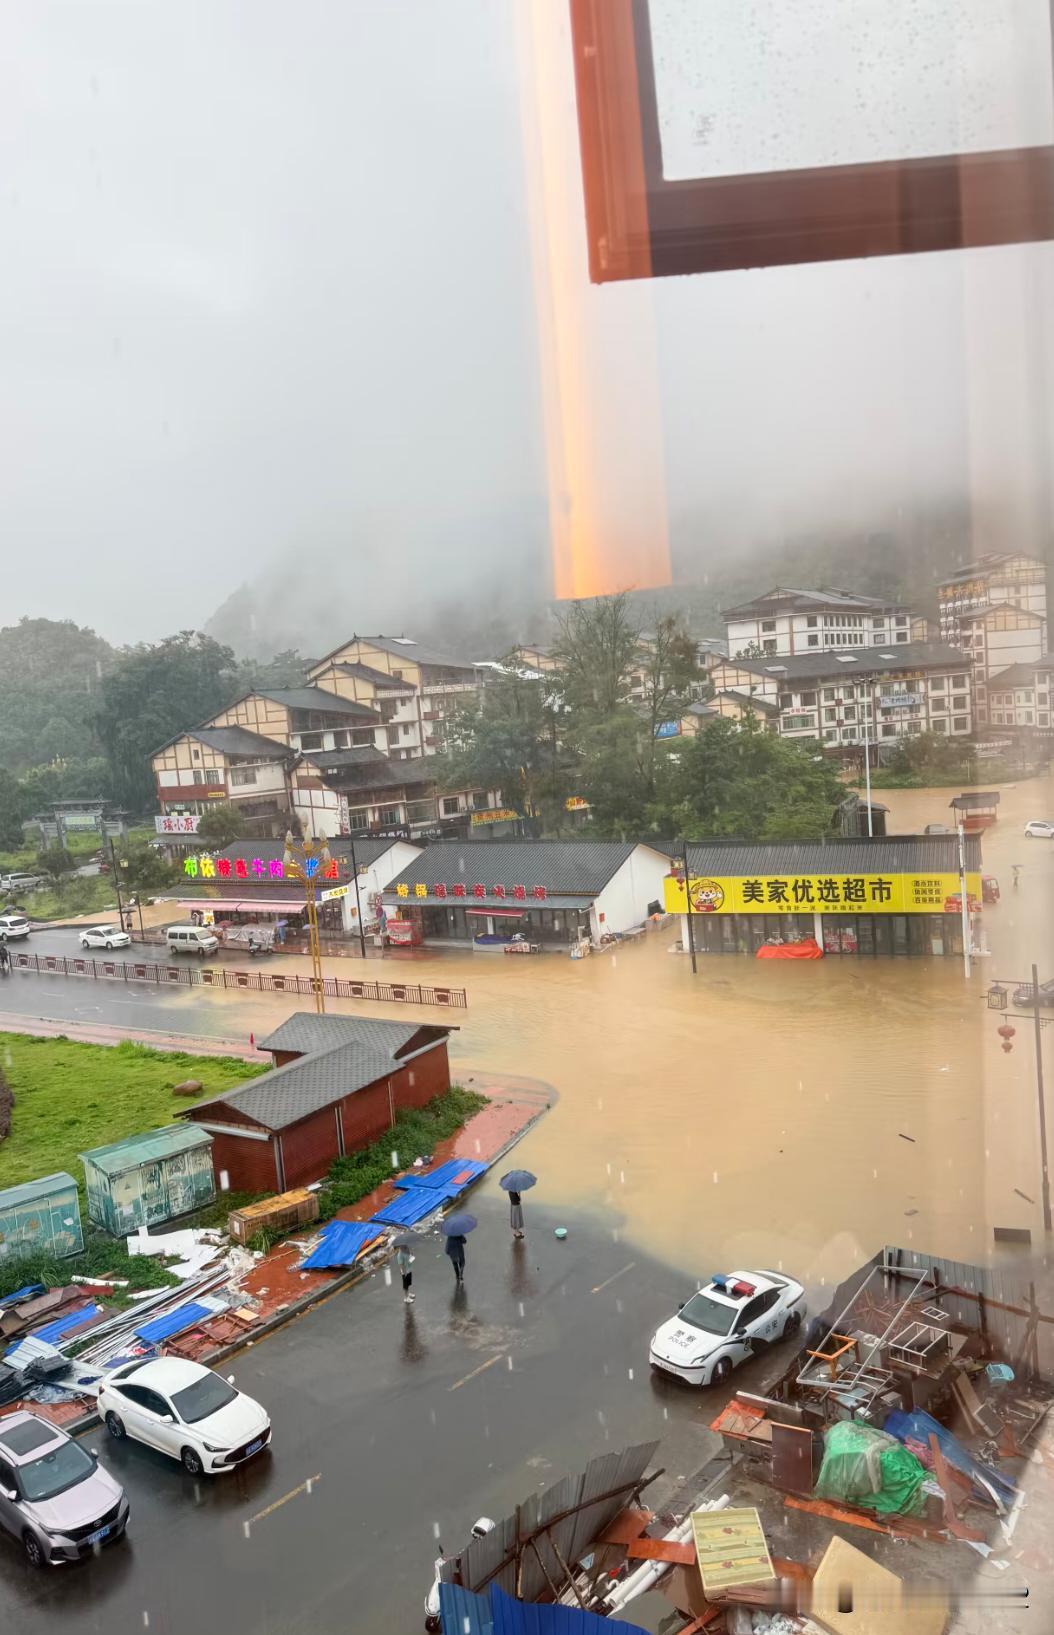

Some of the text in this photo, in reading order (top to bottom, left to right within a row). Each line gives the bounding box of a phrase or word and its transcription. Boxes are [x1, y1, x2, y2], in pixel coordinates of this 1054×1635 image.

[742, 878, 893, 904] 美家优选超市
[667, 1335, 690, 1348] POLICE
